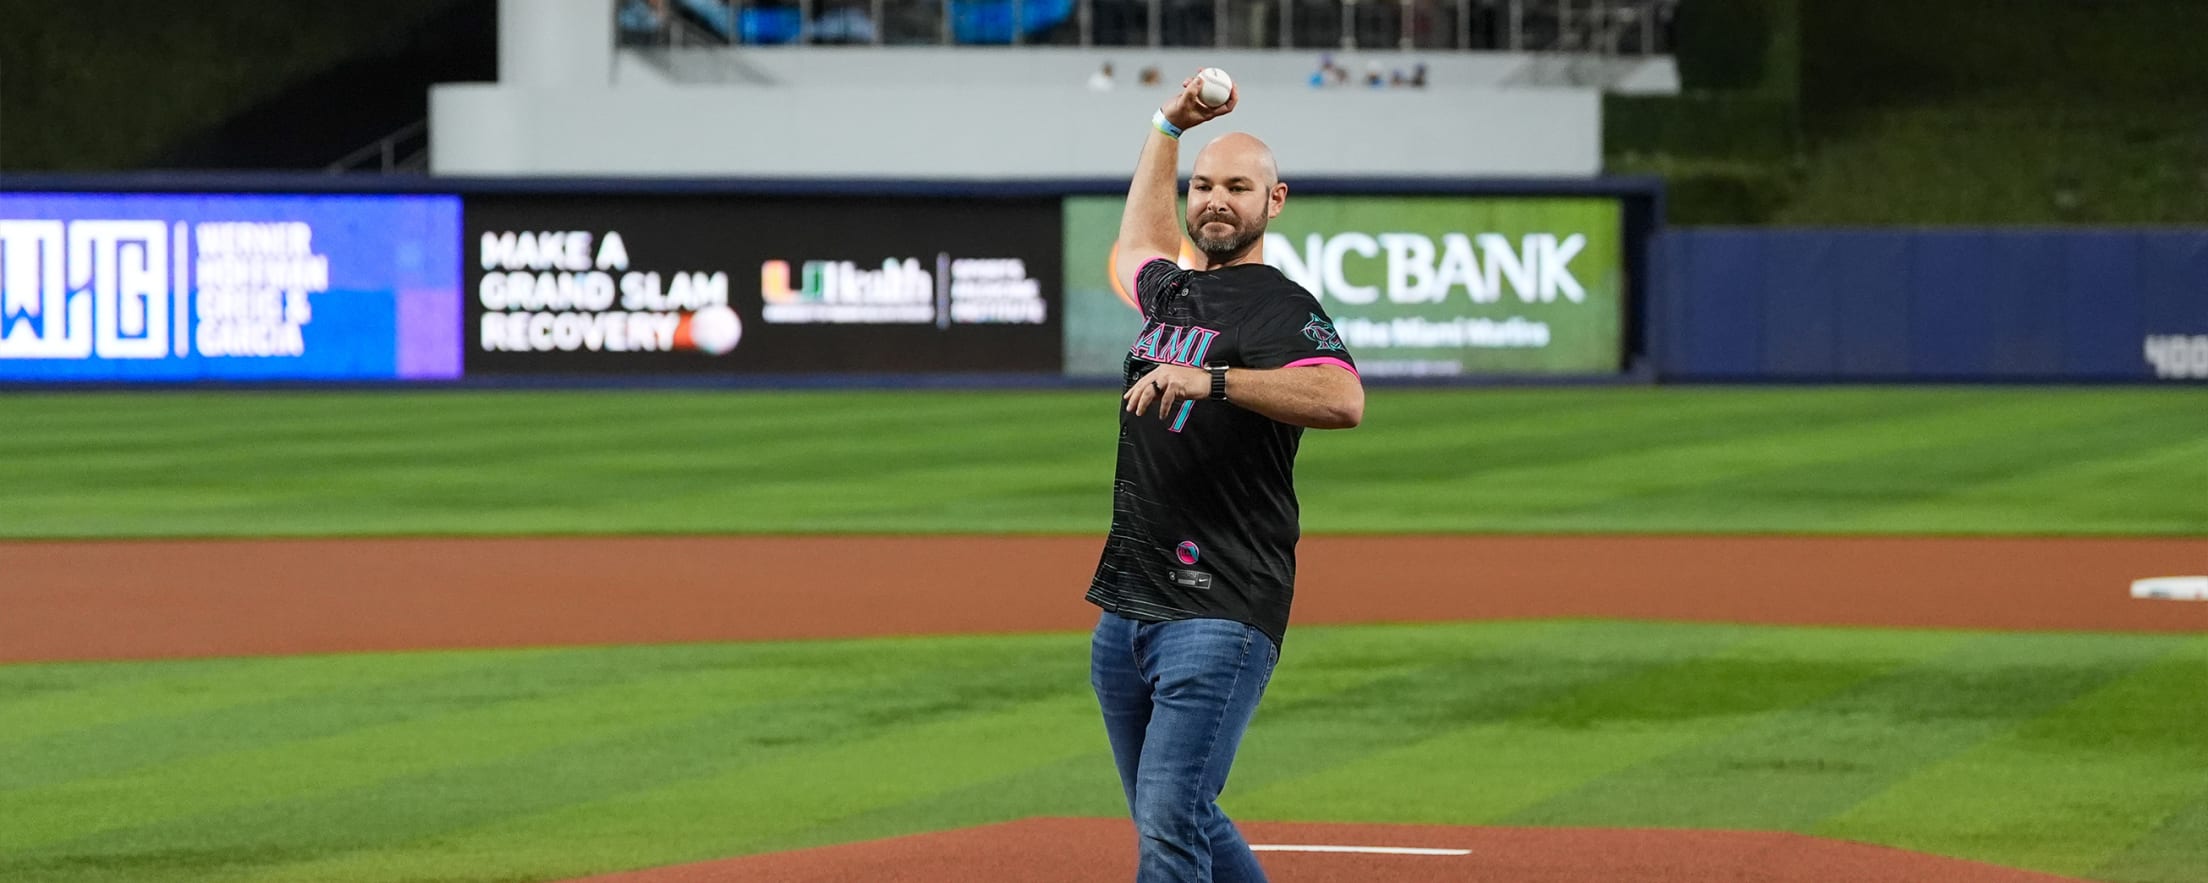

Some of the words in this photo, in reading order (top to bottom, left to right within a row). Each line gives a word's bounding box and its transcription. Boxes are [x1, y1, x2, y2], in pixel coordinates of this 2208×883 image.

[481, 232, 591, 270] MAKE
[597, 232, 629, 270] A
[1263, 231, 1586, 303] NCBANK
[480, 272, 614, 310] GRAND
[621, 272, 728, 310] SLAM
[481, 312, 679, 351] RECOVERY
